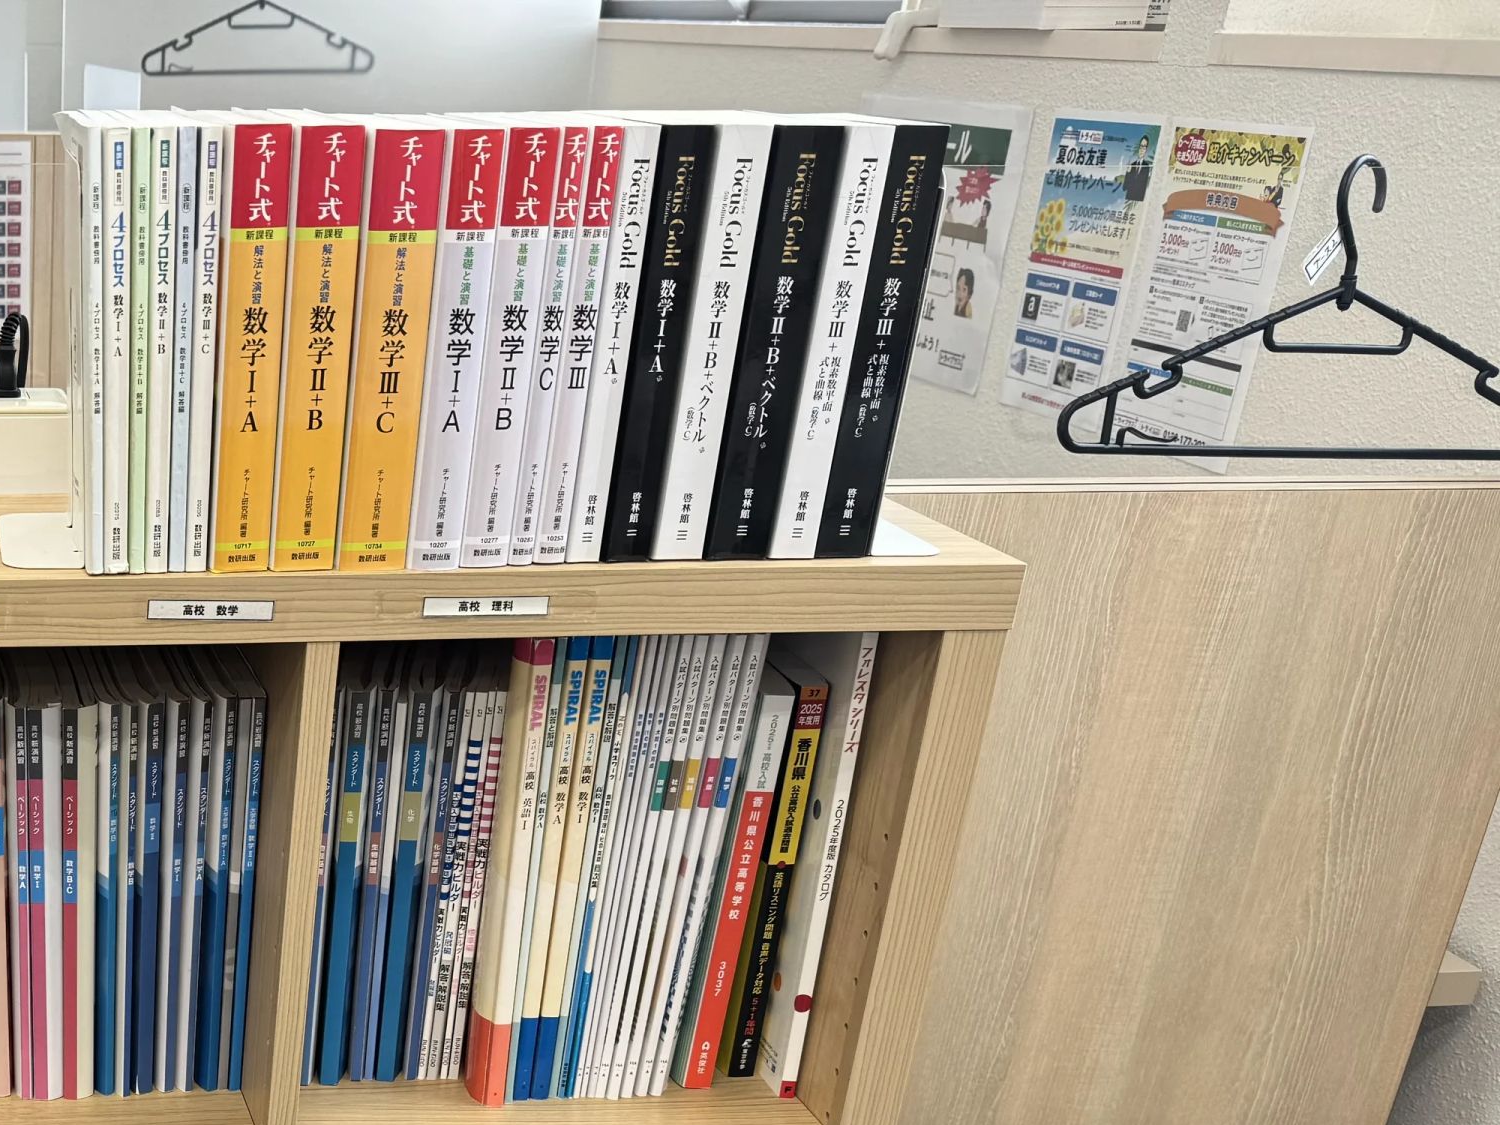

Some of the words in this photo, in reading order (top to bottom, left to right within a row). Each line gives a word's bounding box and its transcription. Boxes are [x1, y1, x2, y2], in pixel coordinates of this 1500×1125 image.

[248, 132, 276, 224] チャート式
[317, 132, 347, 222] チャート式
[514, 132, 547, 221] チャート式
[554, 134, 586, 222] チャート式
[588, 132, 619, 221] チャート式
[1056, 145, 1107, 168] 夏のお友達
[1206, 142, 1295, 167] 紹介キャンペーン
[392, 135, 422, 226] チャート式
[459, 134, 492, 225] チャート式
[627, 159, 650, 216] Focus
[672, 156, 695, 214] Focus
[729, 158, 753, 215] Focus
[791, 154, 816, 210] Focus
[854, 158, 878, 214] Focus
[901, 156, 926, 212] Focus
[1046, 169, 1122, 193] ご紹介キャンペーン
[1206, 193, 1238, 209] 特典内容
[111, 211, 126, 287] 4プロセス
[156, 210, 171, 285] 4プロセス
[245, 229, 274, 240] 新課程
[315, 229, 343, 239] 新課程
[388, 232, 416, 242] 新課程
[620, 221, 641, 268] Gold
[664, 219, 685, 266] Gold
[720, 221, 742, 268] Gold
[781, 216, 804, 263] Gold
[843, 220, 865, 267] Gold
[890, 217, 913, 264] Gold
[252, 245, 265, 304] 解法と演習
[320, 244, 333, 303] 解法と演習
[459, 247, 474, 305] 基礎と演習
[513, 243, 529, 302] 基礎と演習
[539, 305, 563, 392] 数学C
[585, 495, 598, 526] 啓林館
[228, 552, 257, 562] 数研出版
[234, 542, 252, 550] 10717
[291, 551, 320, 562] 数研出版
[182, 604, 206, 617] 高校
[216, 604, 239, 617] 数学
[458, 600, 481, 613] 高校
[492, 599, 514, 612] 理科
[564, 671, 582, 726] SPIRAL
[850, 646, 873, 704] フォレスタ
[529, 675, 547, 731] SPIRAL
[798, 716, 820, 726] 年度用
[800, 704, 822, 714] 2025
[844, 707, 866, 754] シリーズ
[792, 738, 812, 780] 香川県
[728, 796, 764, 921] 香川県公立高等学校
[819, 864, 833, 901] カタログ
[714, 961, 726, 997] 3037
